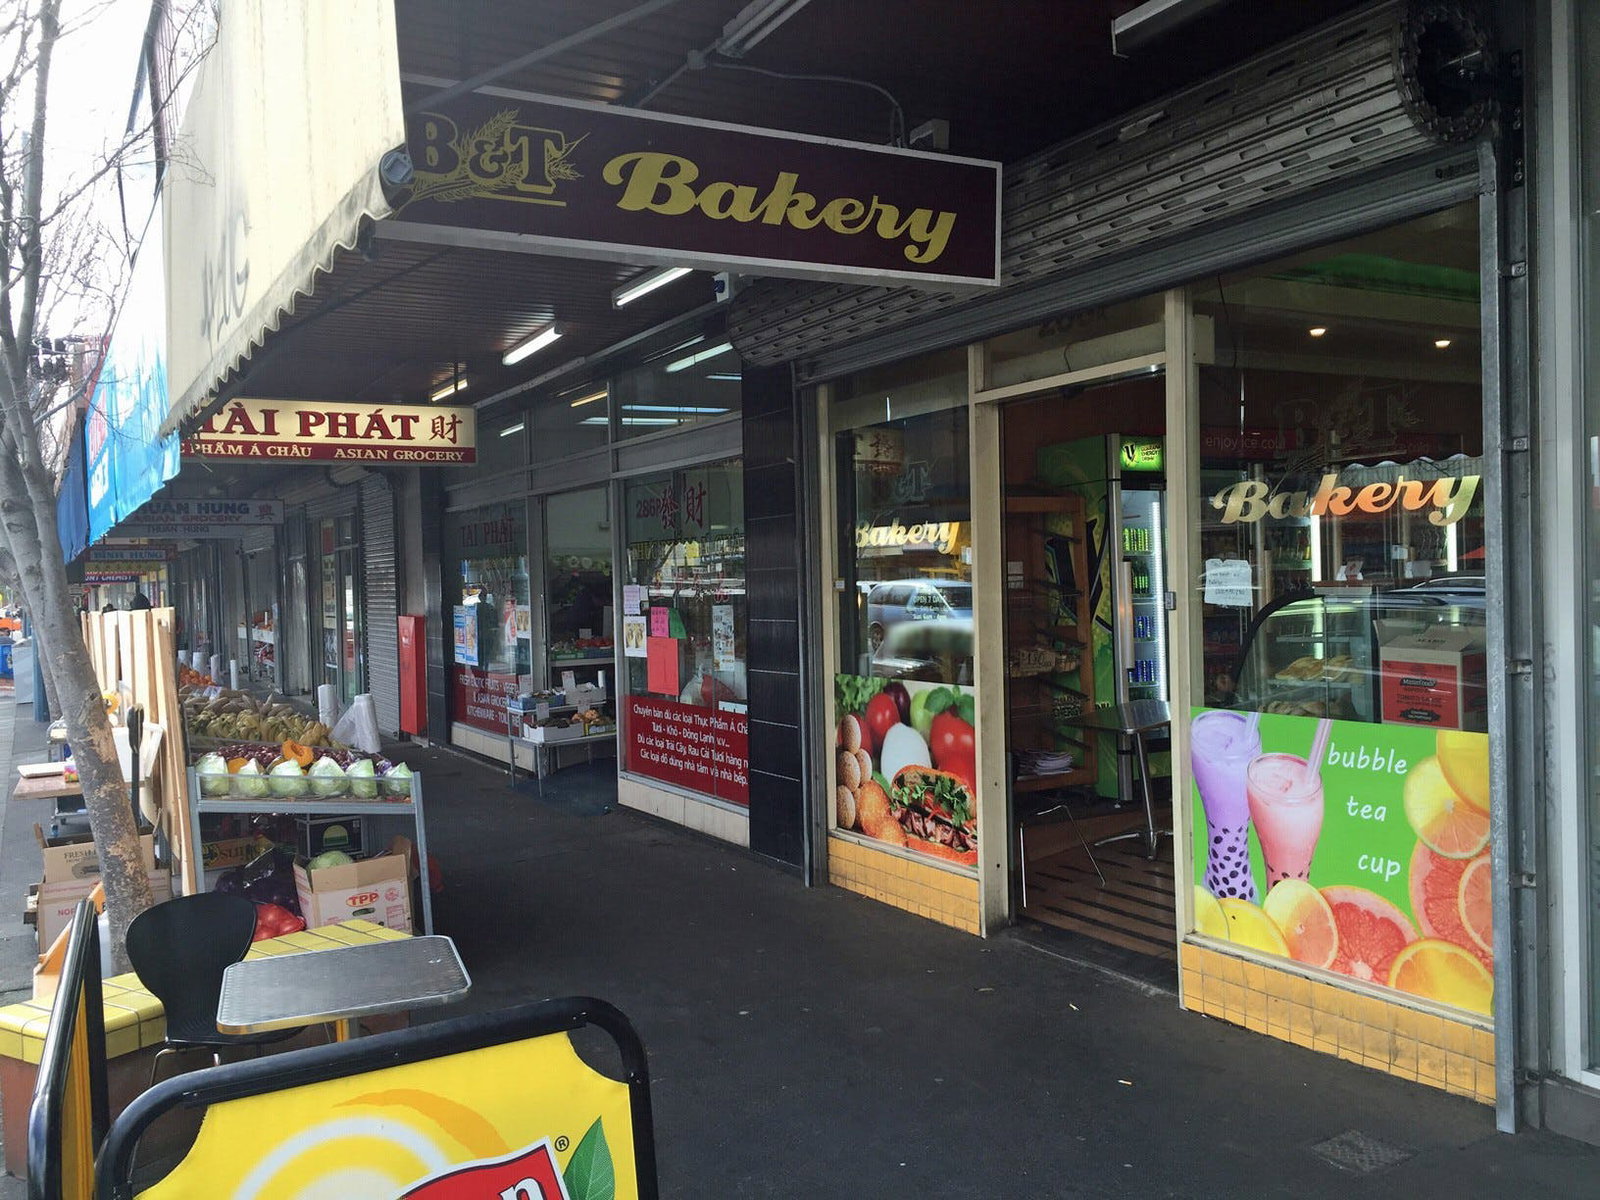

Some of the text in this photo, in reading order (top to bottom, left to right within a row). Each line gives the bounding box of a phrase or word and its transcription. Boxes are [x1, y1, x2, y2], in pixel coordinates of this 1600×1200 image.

[602, 152, 957, 264] Bakery
[296, 408, 420, 441] PHÁT
[429, 413, 463, 445] 財
[334, 448, 389, 461] ASIAN
[394, 449, 464, 462] GROCERY
[1206, 436, 1239, 451] enjoy
[1212, 473, 1481, 527] Bakery
[1328, 743, 1408, 775] bubble
[1347, 796, 1387, 822] tea
[1357, 854, 1401, 882] cup
[348, 891, 380, 906] TPP
